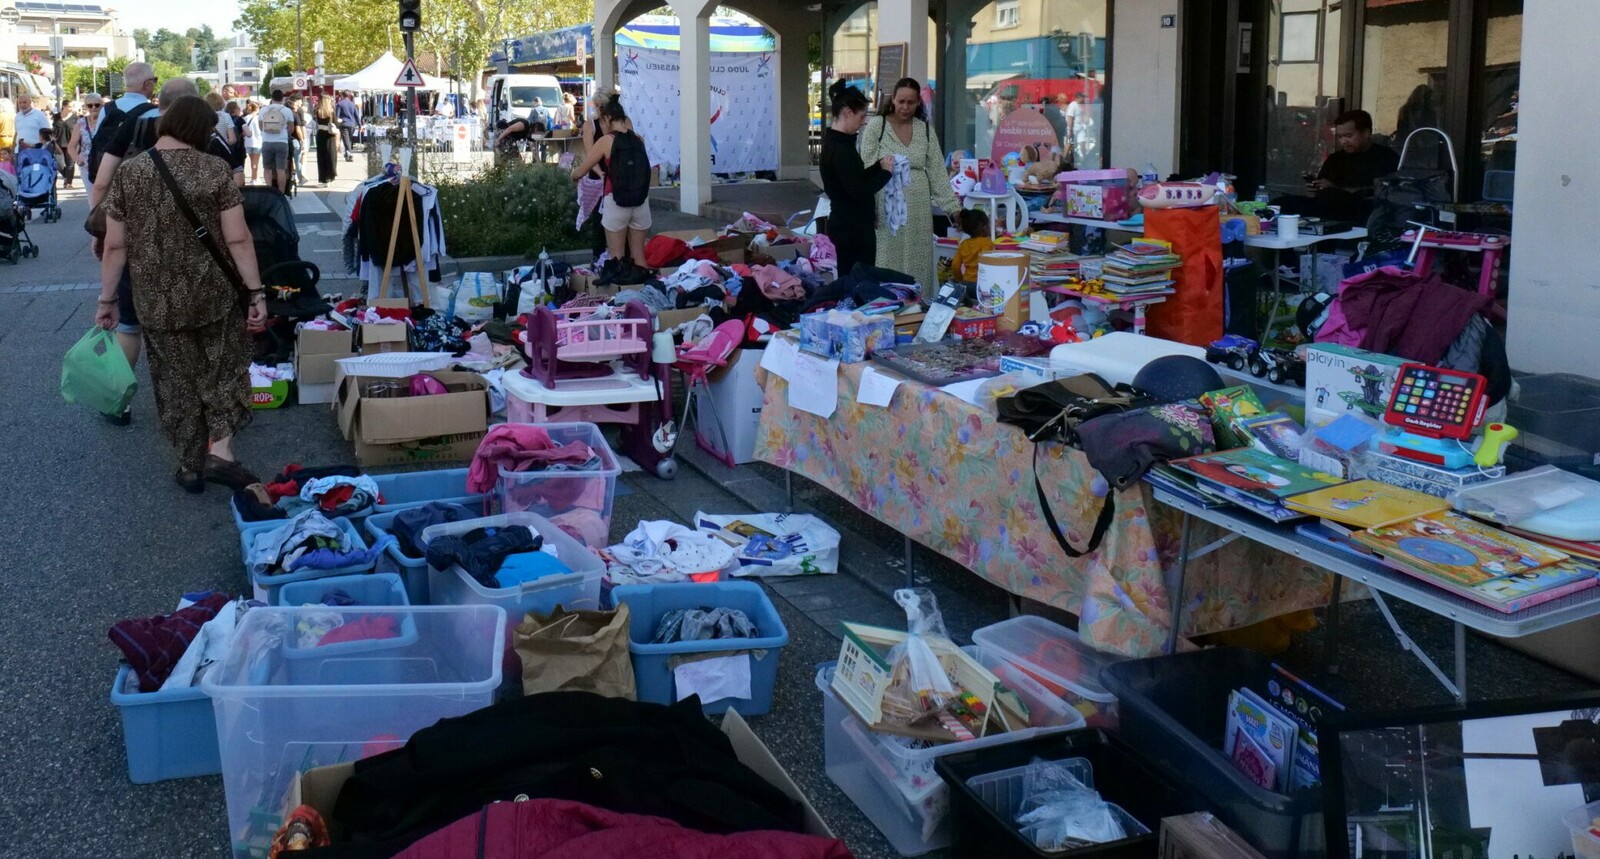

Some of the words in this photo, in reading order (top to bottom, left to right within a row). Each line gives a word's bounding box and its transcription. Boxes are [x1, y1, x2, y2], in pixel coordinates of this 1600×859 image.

[1163, 17, 1170, 26] 10
[999, 126, 1022, 135] invisible
[250, 392, 274, 402] ROPS
[1419, 419, 1442, 430] Register
